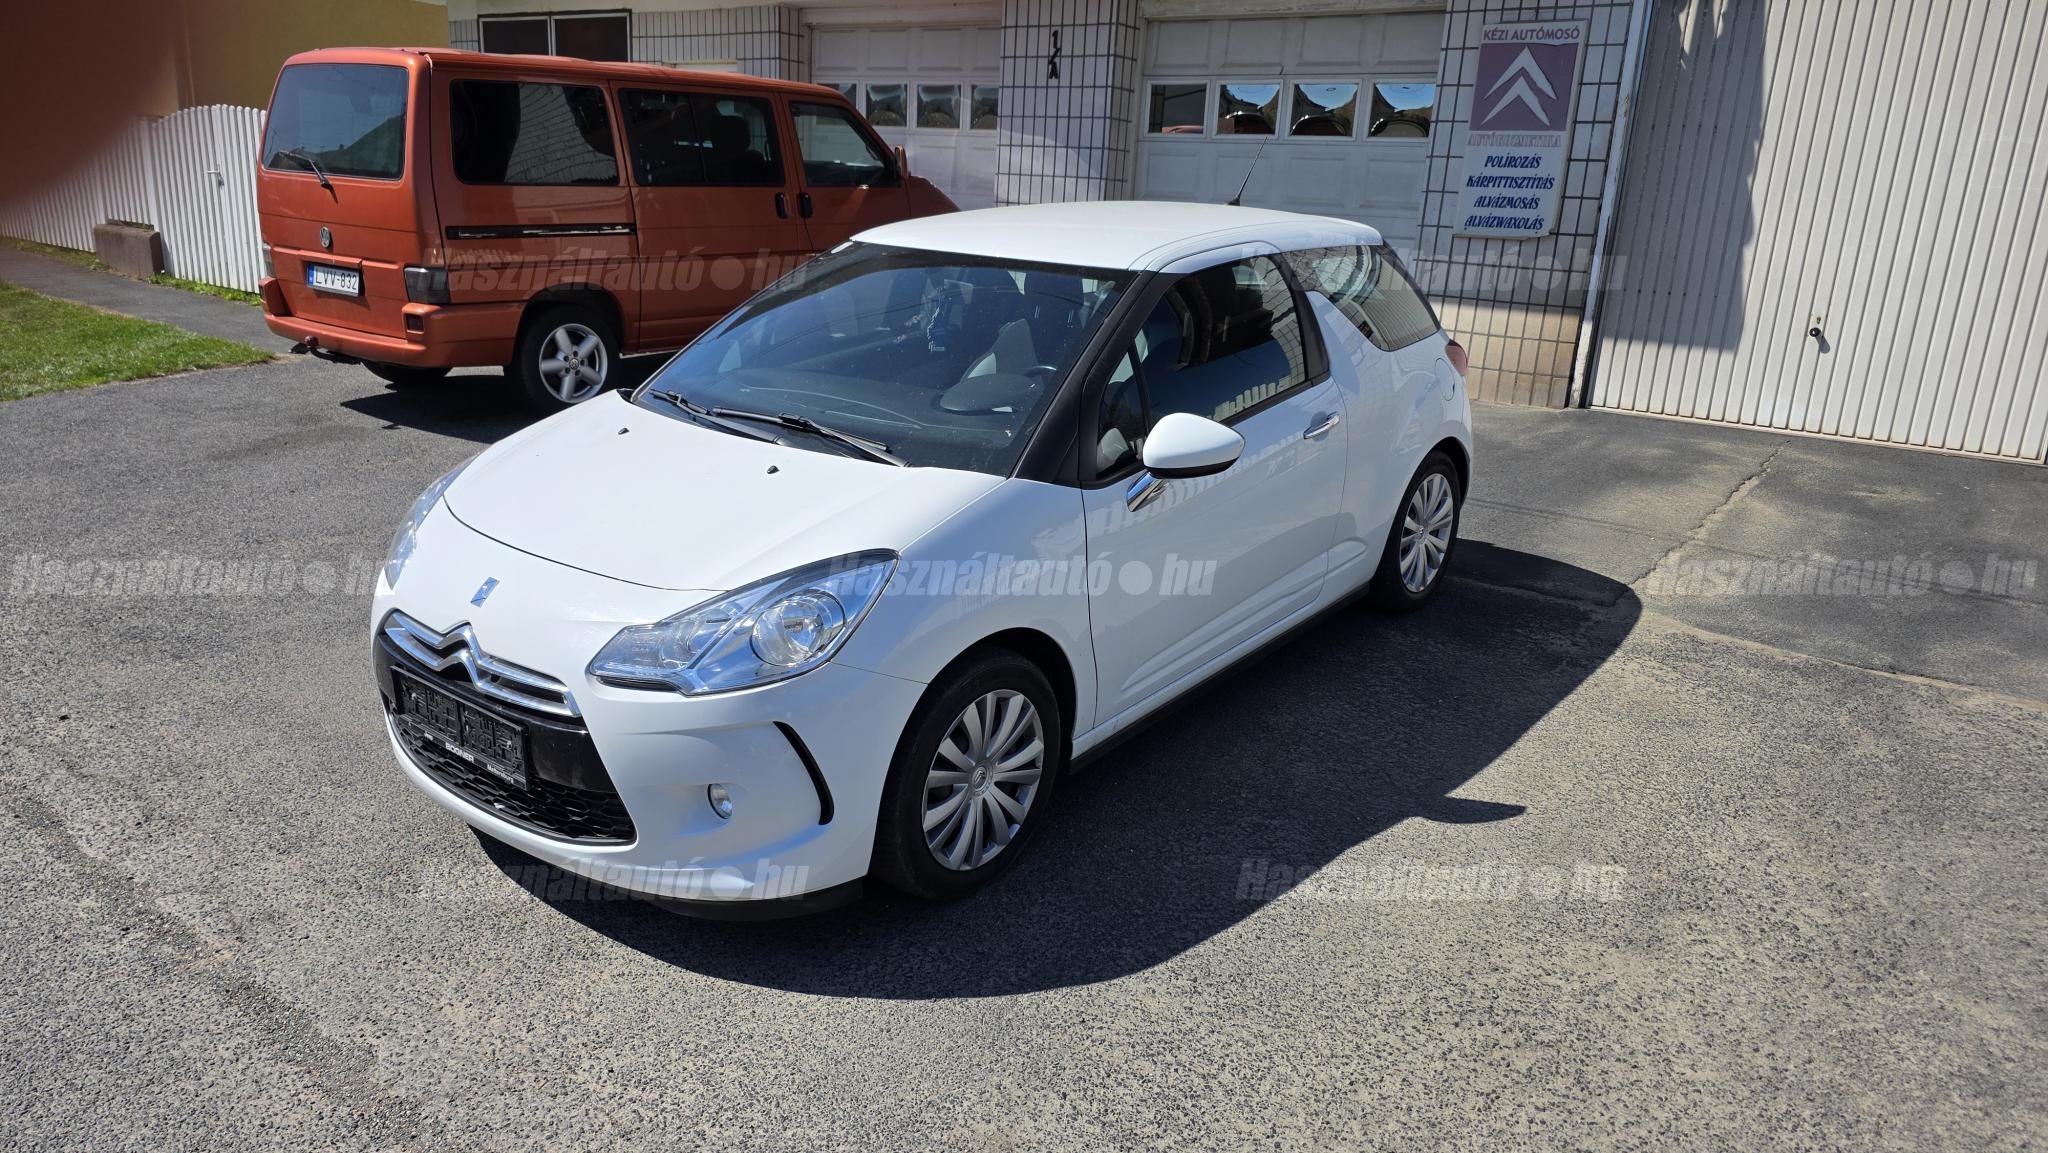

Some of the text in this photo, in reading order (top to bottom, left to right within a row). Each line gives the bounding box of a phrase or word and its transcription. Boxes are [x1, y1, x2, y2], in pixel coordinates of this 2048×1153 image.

[1483, 25, 1580, 41] KÉZI AUTÓMOSÓ
[1484, 152, 1542, 169] POLÍROZÁS
[1466, 172, 1556, 190] KÁRPITTISZTÍTÁS
[1473, 193, 1541, 210] ALVÁZMOSÁS
[1464, 212, 1545, 231] ALVÁZWAXOLÁS
[315, 266, 357, 291] LVV-832
